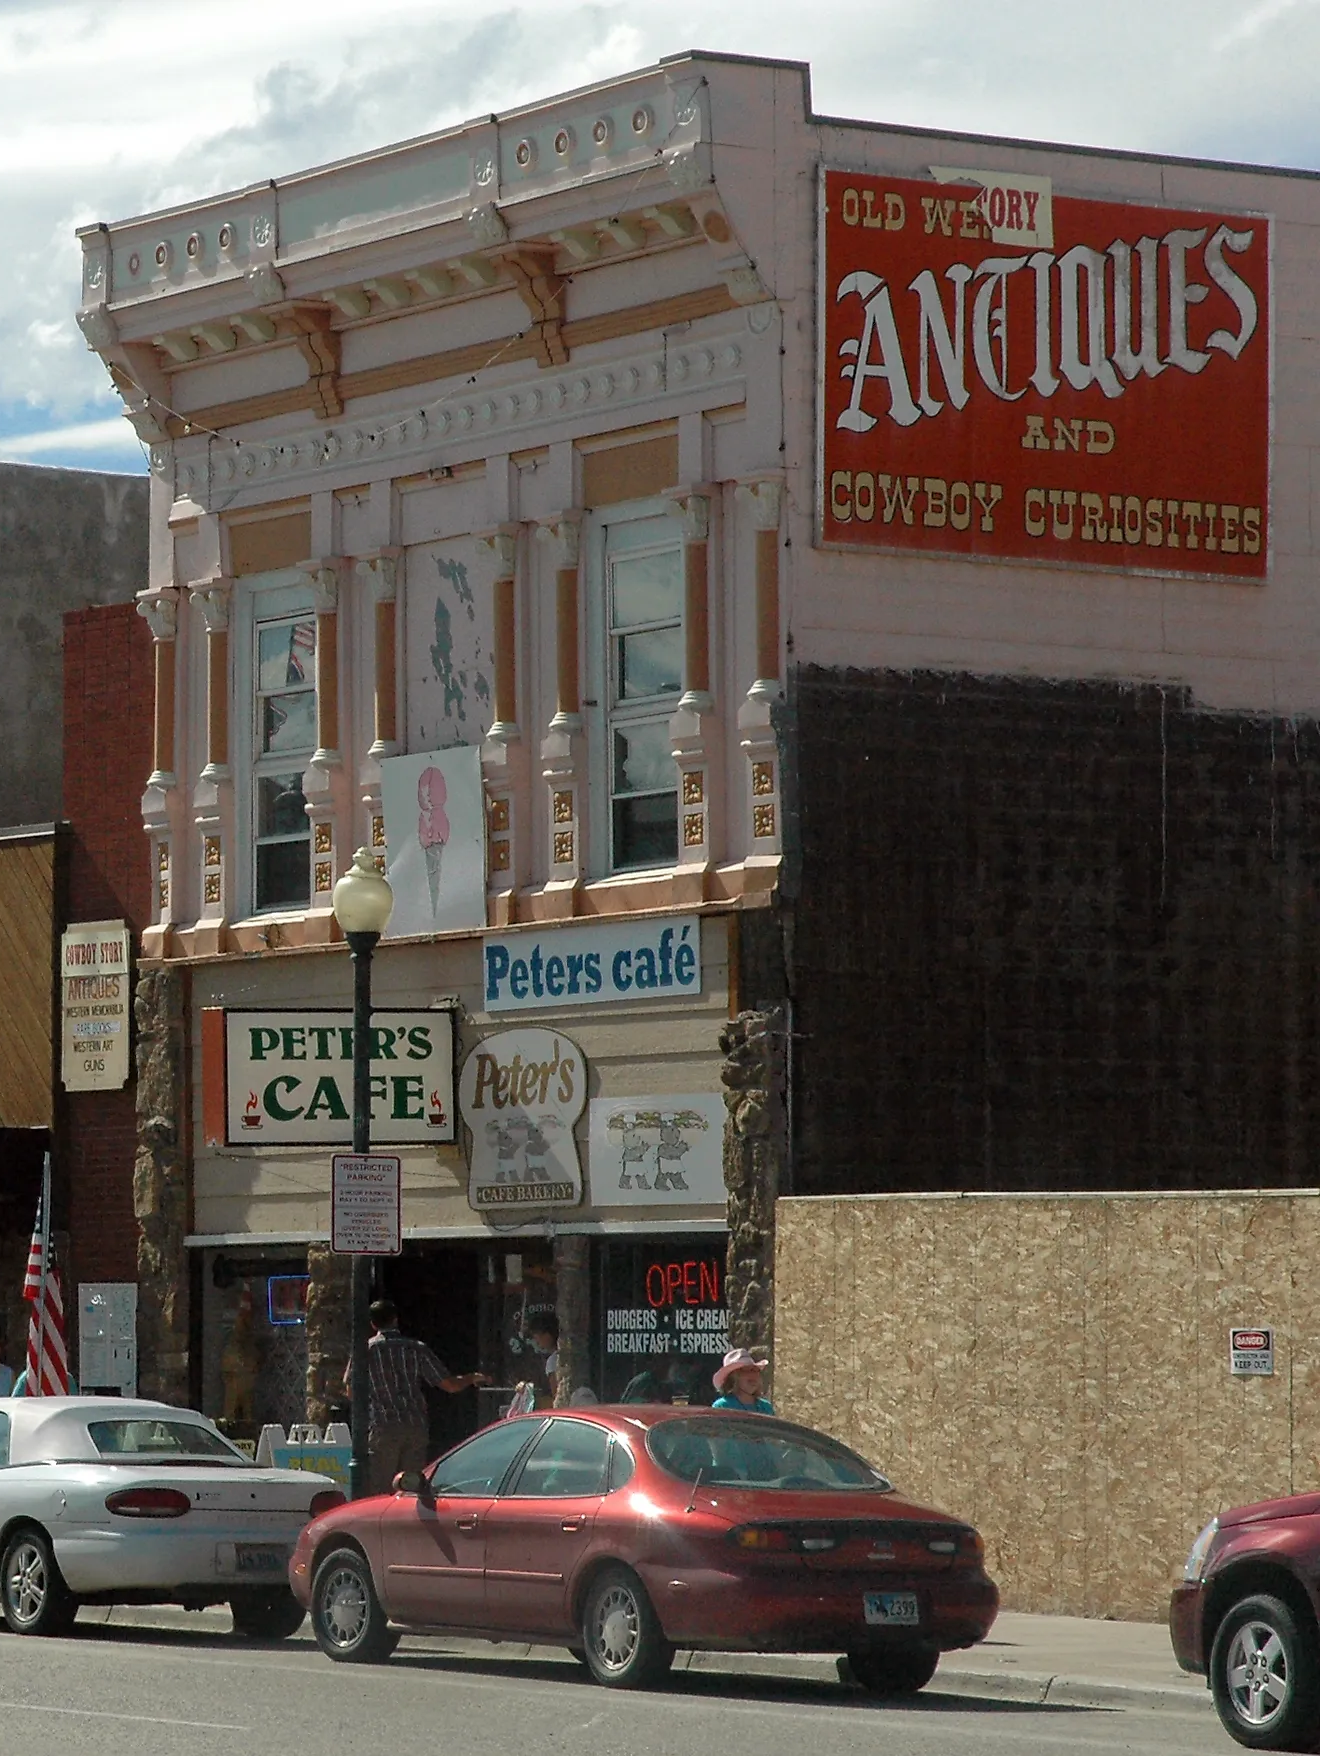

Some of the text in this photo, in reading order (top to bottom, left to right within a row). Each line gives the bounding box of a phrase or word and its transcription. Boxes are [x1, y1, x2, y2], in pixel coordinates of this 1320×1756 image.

[842, 187, 992, 240] OLD WE
[836, 223, 1259, 433] ANTIQUES
[1021, 414, 1117, 455] AND
[830, 469, 1262, 555] COWBOY CURIOSITIES
[65, 941, 124, 967] COWBOY STORY
[485, 924, 696, 1001] Peters café
[67, 975, 121, 1001] ANTIQUES
[73, 1039, 114, 1053] WESTERN ART
[248, 1025, 434, 1061] PETER'S
[83, 1059, 106, 1072] GUNS
[470, 1038, 575, 1110] Peter's
[516, 1183, 569, 1200] BAKERY
[645, 1260, 719, 1308] OPEN
[607, 1309, 730, 1331] BURGERS ICE CREA
[607, 1333, 671, 1354] BREAKFAST
[1235, 1336, 1265, 1346] DANGER
[1235, 1360, 1267, 1369] KEEP OUT
